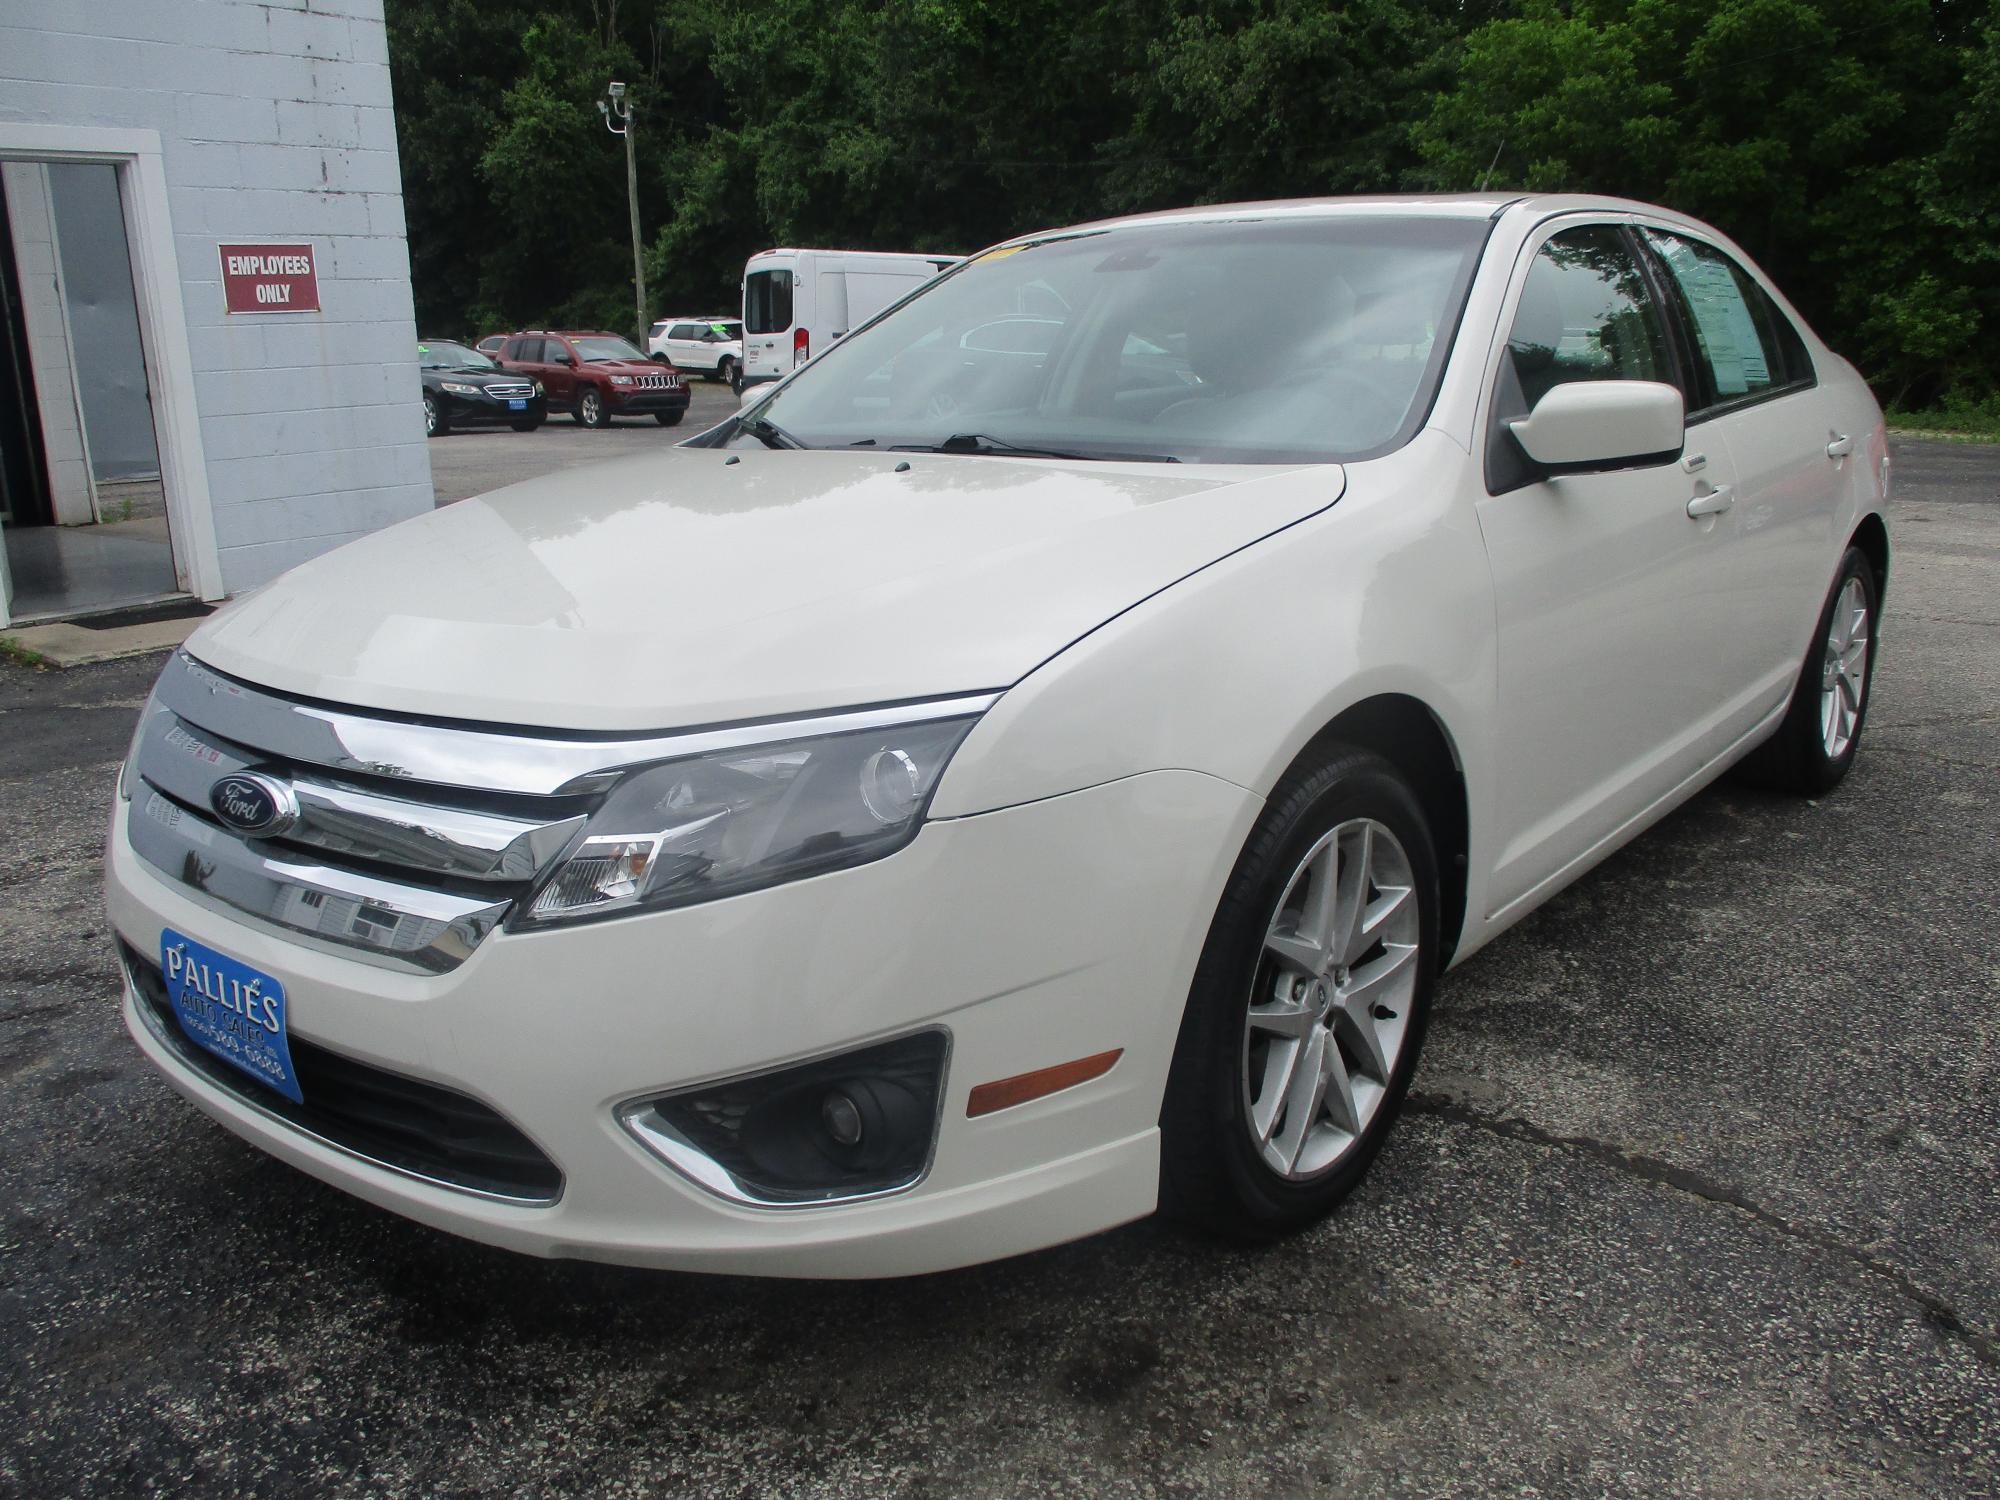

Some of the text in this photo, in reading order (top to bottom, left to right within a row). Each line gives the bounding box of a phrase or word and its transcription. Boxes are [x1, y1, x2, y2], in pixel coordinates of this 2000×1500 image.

[227, 255, 310, 275] EMPLOYEES
[255, 284, 290, 304] ONLY
[221, 782, 261, 821] Ford
[180, 989, 265, 1048] AUTO SALES
